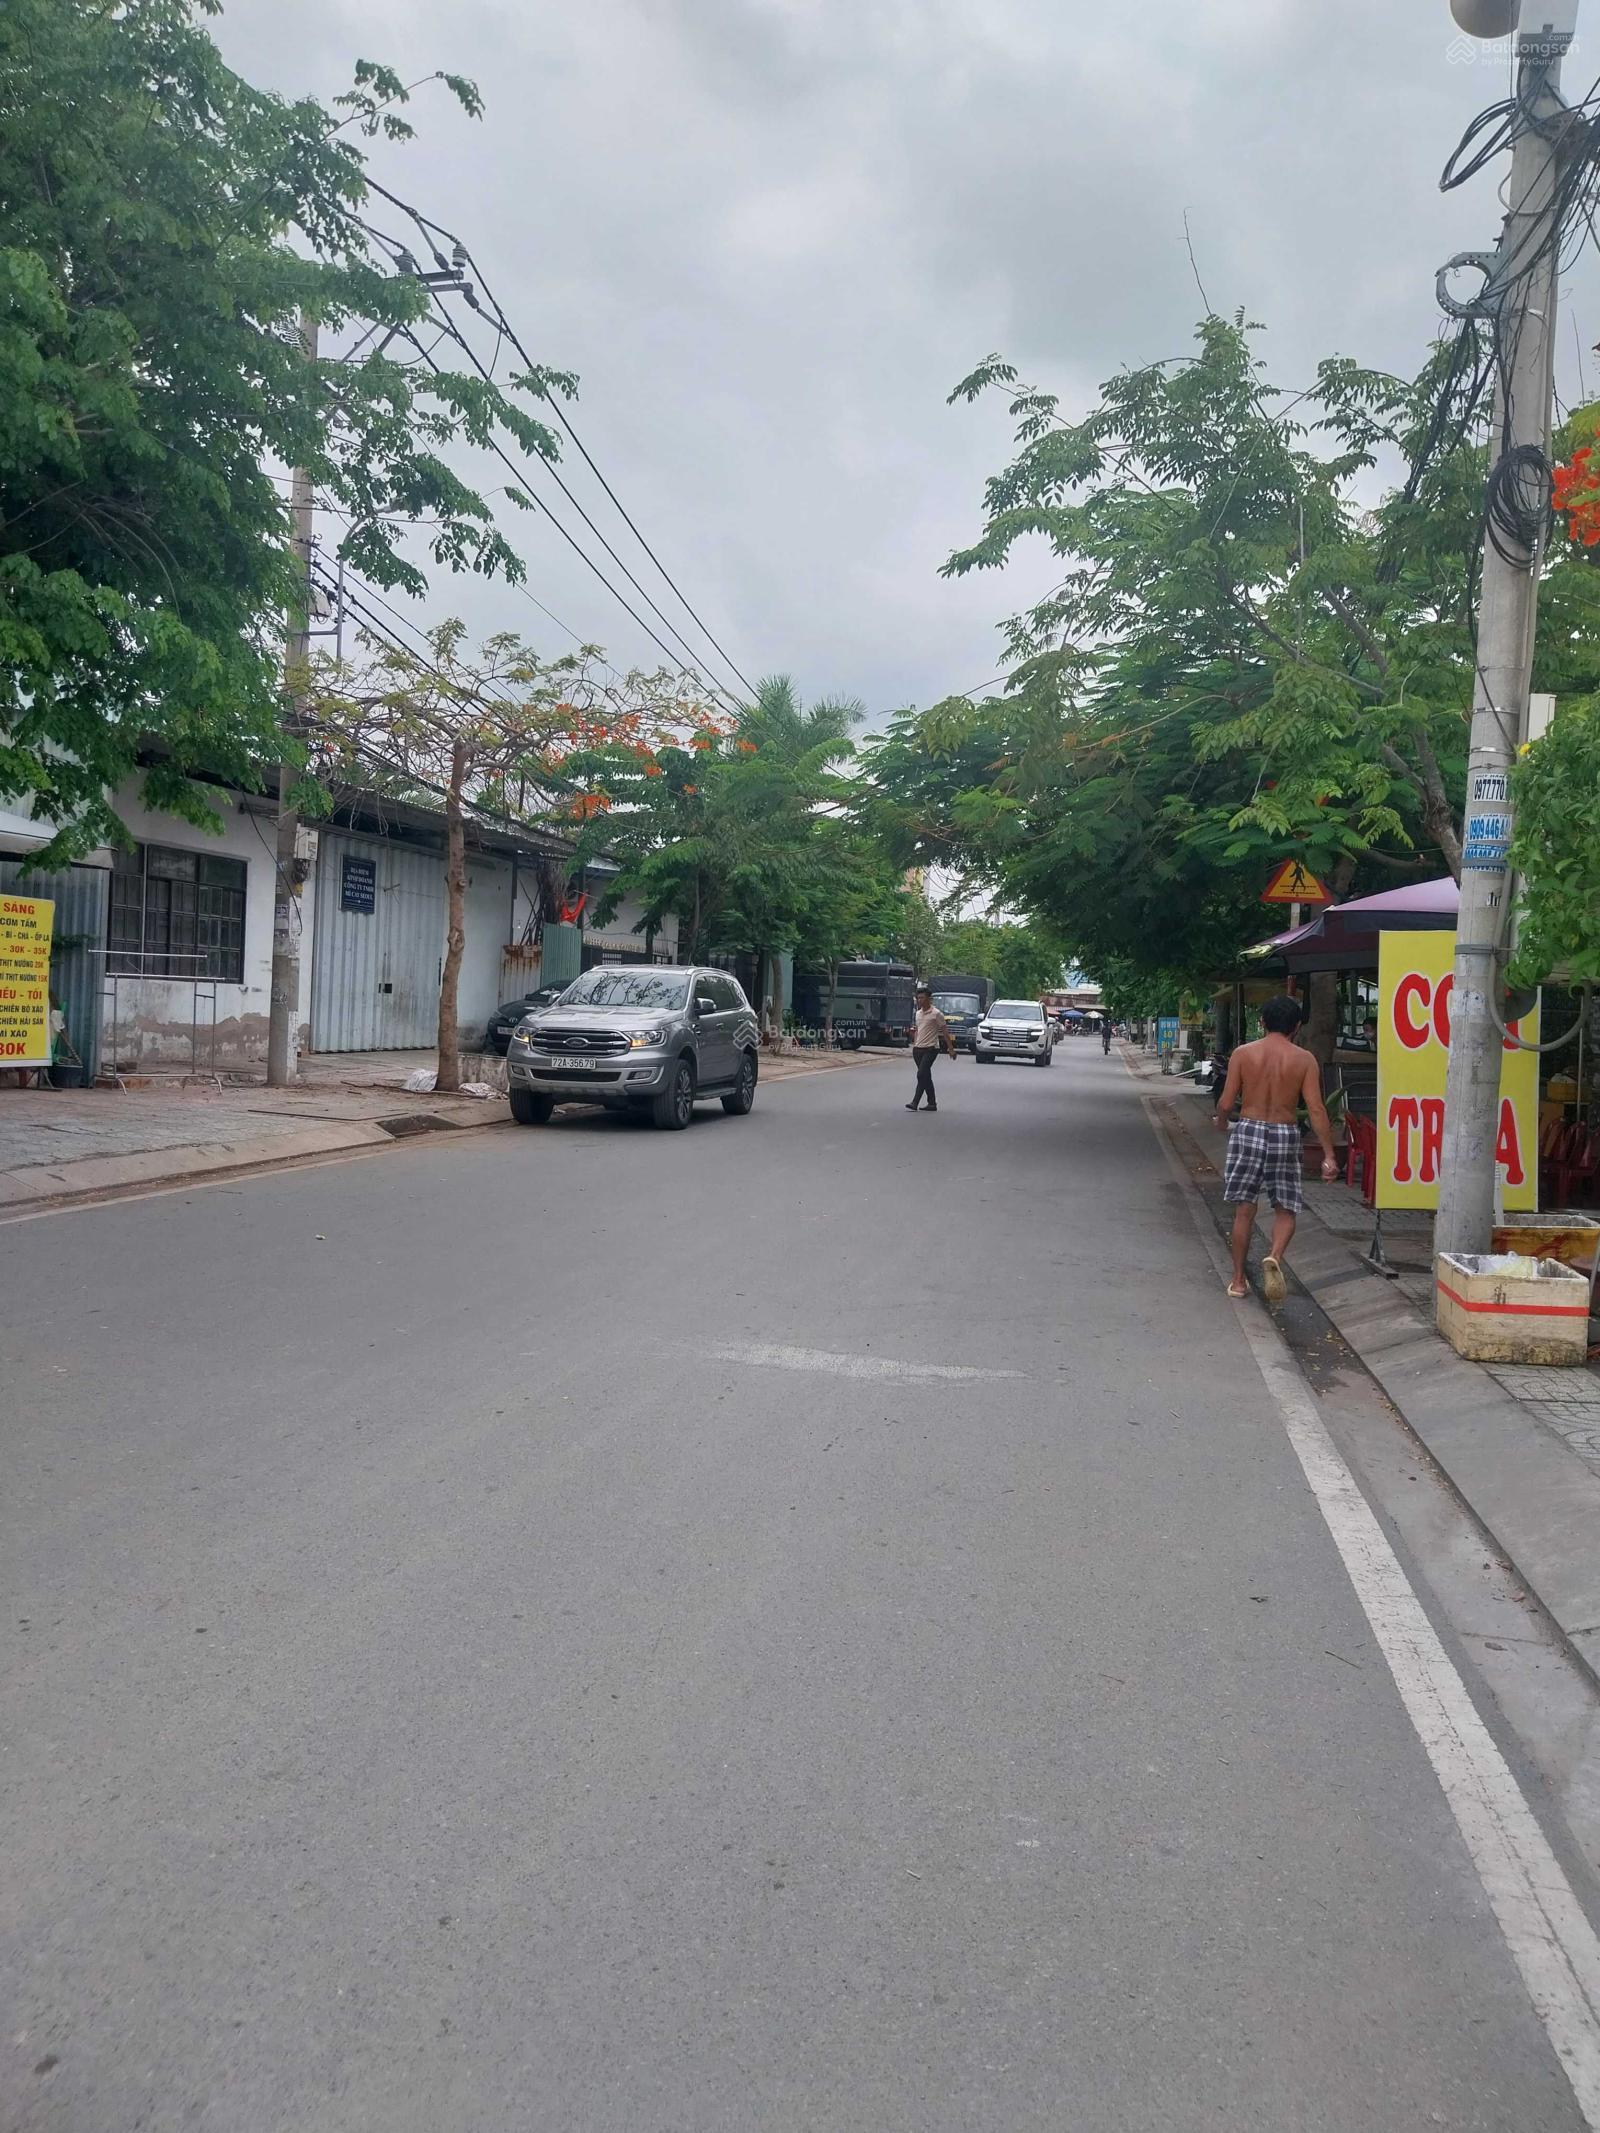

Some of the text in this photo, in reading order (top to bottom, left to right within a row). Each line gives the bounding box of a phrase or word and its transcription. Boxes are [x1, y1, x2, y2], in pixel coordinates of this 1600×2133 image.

[3, 901, 35, 915] SÁNG
[9, 945, 47, 955] 30K 35K
[27, 986, 43, 1000] TỐI
[1388, 1096, 1524, 1185] TRA
